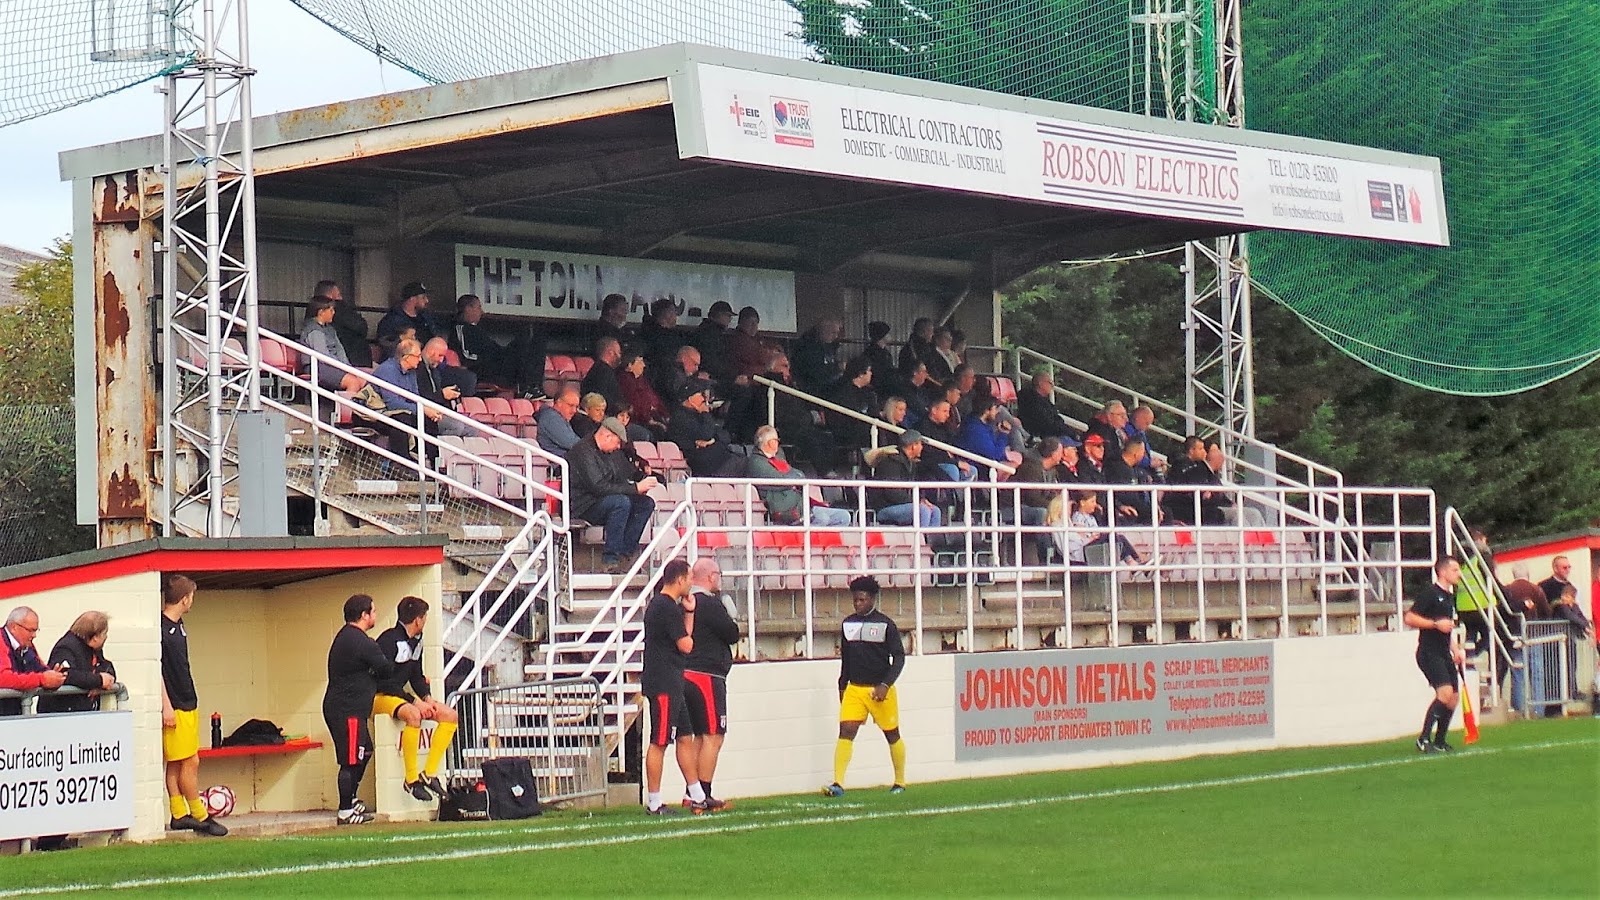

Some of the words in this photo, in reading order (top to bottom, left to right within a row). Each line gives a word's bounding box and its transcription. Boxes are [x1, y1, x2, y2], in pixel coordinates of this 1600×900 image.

[788, 102, 809, 117] TRUST
[790, 116, 811, 130] MARK
[840, 107, 916, 139] ELECTRICAL
[918, 118, 1003, 151] CONTRACTORS
[843, 138, 887, 158] DOMESTIC
[894, 144, 950, 167] COMMERCIAL
[957, 153, 1006, 174] INDUSTRIAL
[1042, 140, 1126, 186] ROBSON
[1135, 154, 1239, 201] ELECTRICS
[463, 255, 523, 306] THE
[1164, 660, 1192, 677] SCRAP
[1194, 658, 1219, 675] METAL
[1222, 655, 1269, 673] MERCHANTS
[960, 666, 1067, 711] JOHNSON
[1076, 661, 1156, 704] METALS
[1054, 708, 1088, 721] SPONSORS)
[1169, 695, 1211, 714] Telephone:
[1214, 692, 1236, 708] 01278
[964, 728, 997, 747] PROUD
[1000, 728, 1011, 744] TO
[1015, 725, 1056, 744] SUPPORT
[1058, 721, 1112, 741] BRIDGWATER
[1115, 720, 1139, 737] TOWN
[1141, 719, 1152, 735] FC
[1165, 710, 1269, 734] www.johnsonmetals.co.uk
[0, 745, 63, 772] Surfacing
[70, 740, 120, 765] Limited
[0, 780, 49, 810] 01275
[56, 774, 118, 805] 392719
